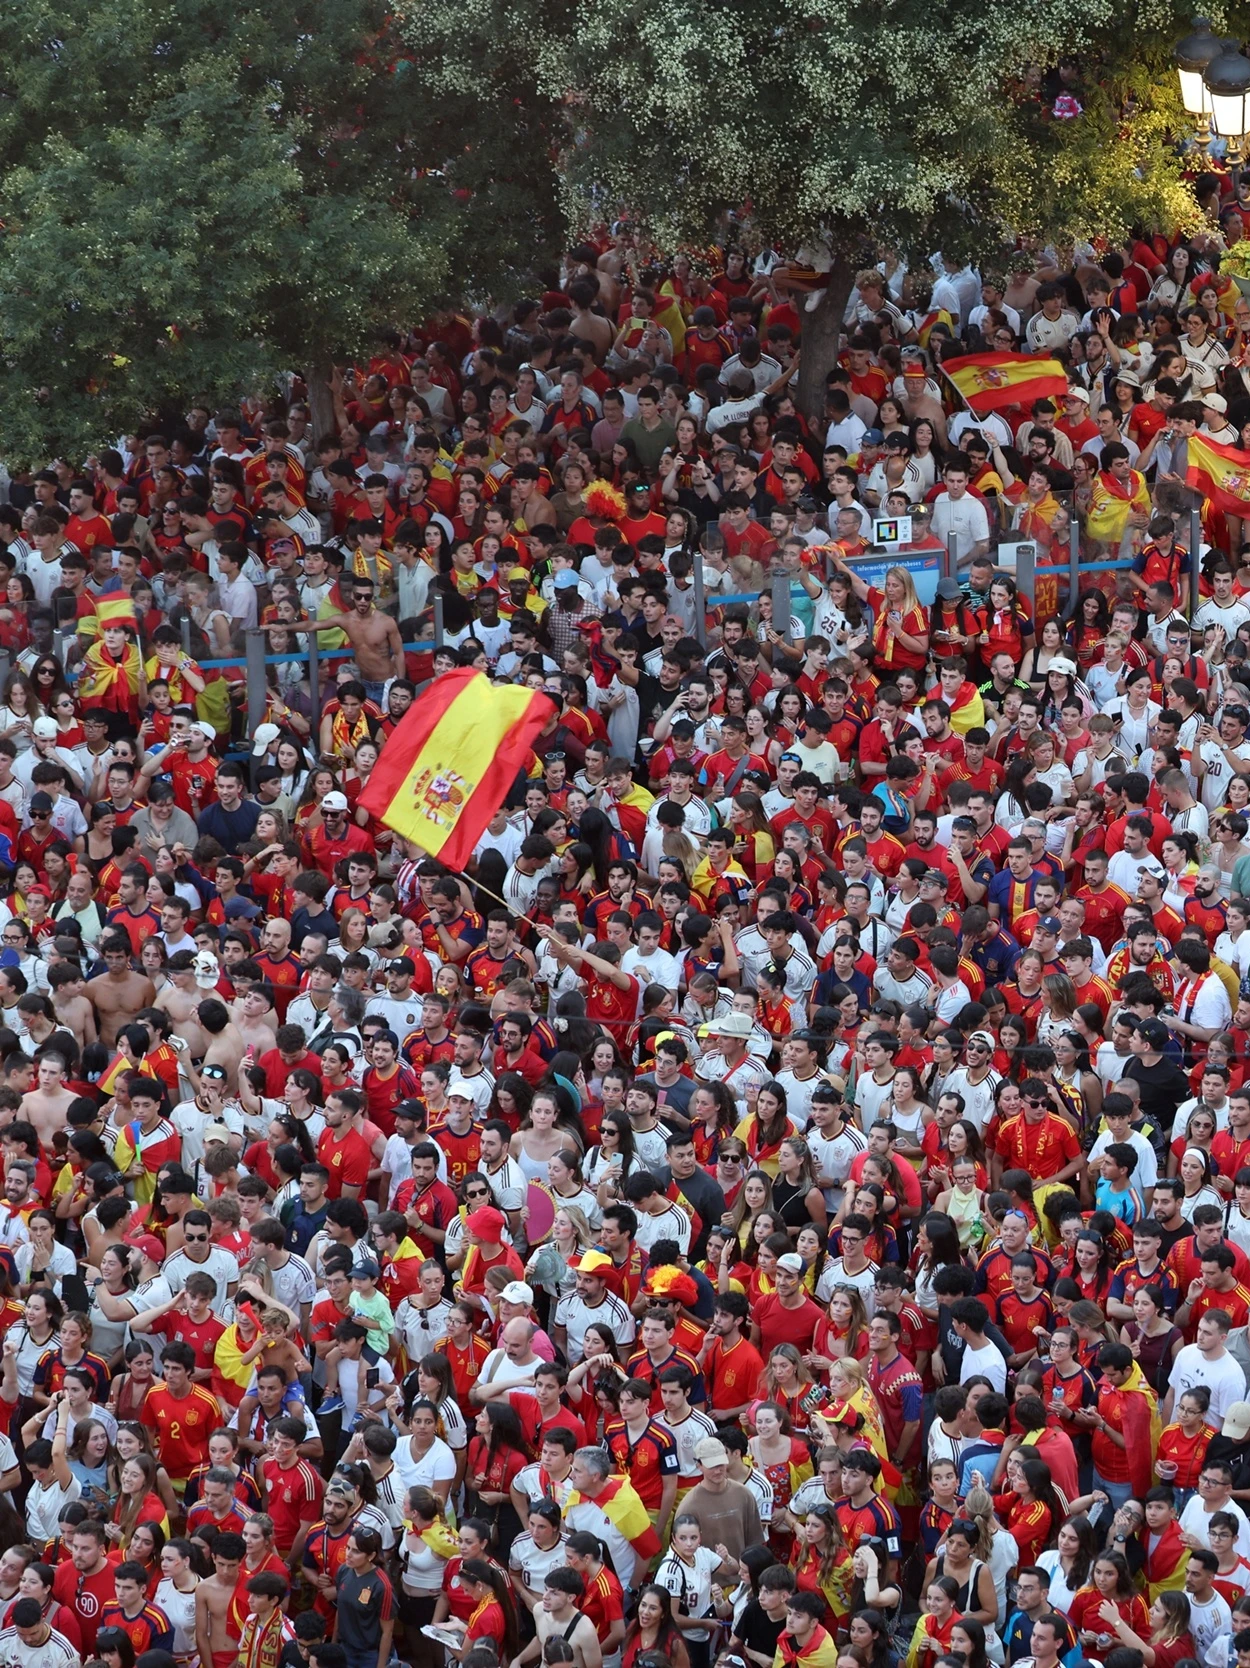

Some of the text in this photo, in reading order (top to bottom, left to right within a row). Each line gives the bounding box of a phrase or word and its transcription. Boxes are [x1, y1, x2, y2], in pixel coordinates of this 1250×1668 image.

[820, 615, 837, 634] 25
[1206, 760, 1222, 777] 20
[487, 981, 497, 997] 2
[453, 1161, 467, 1179] 21
[170, 1421, 180, 1439] 2
[81, 1598, 92, 1613] 90
